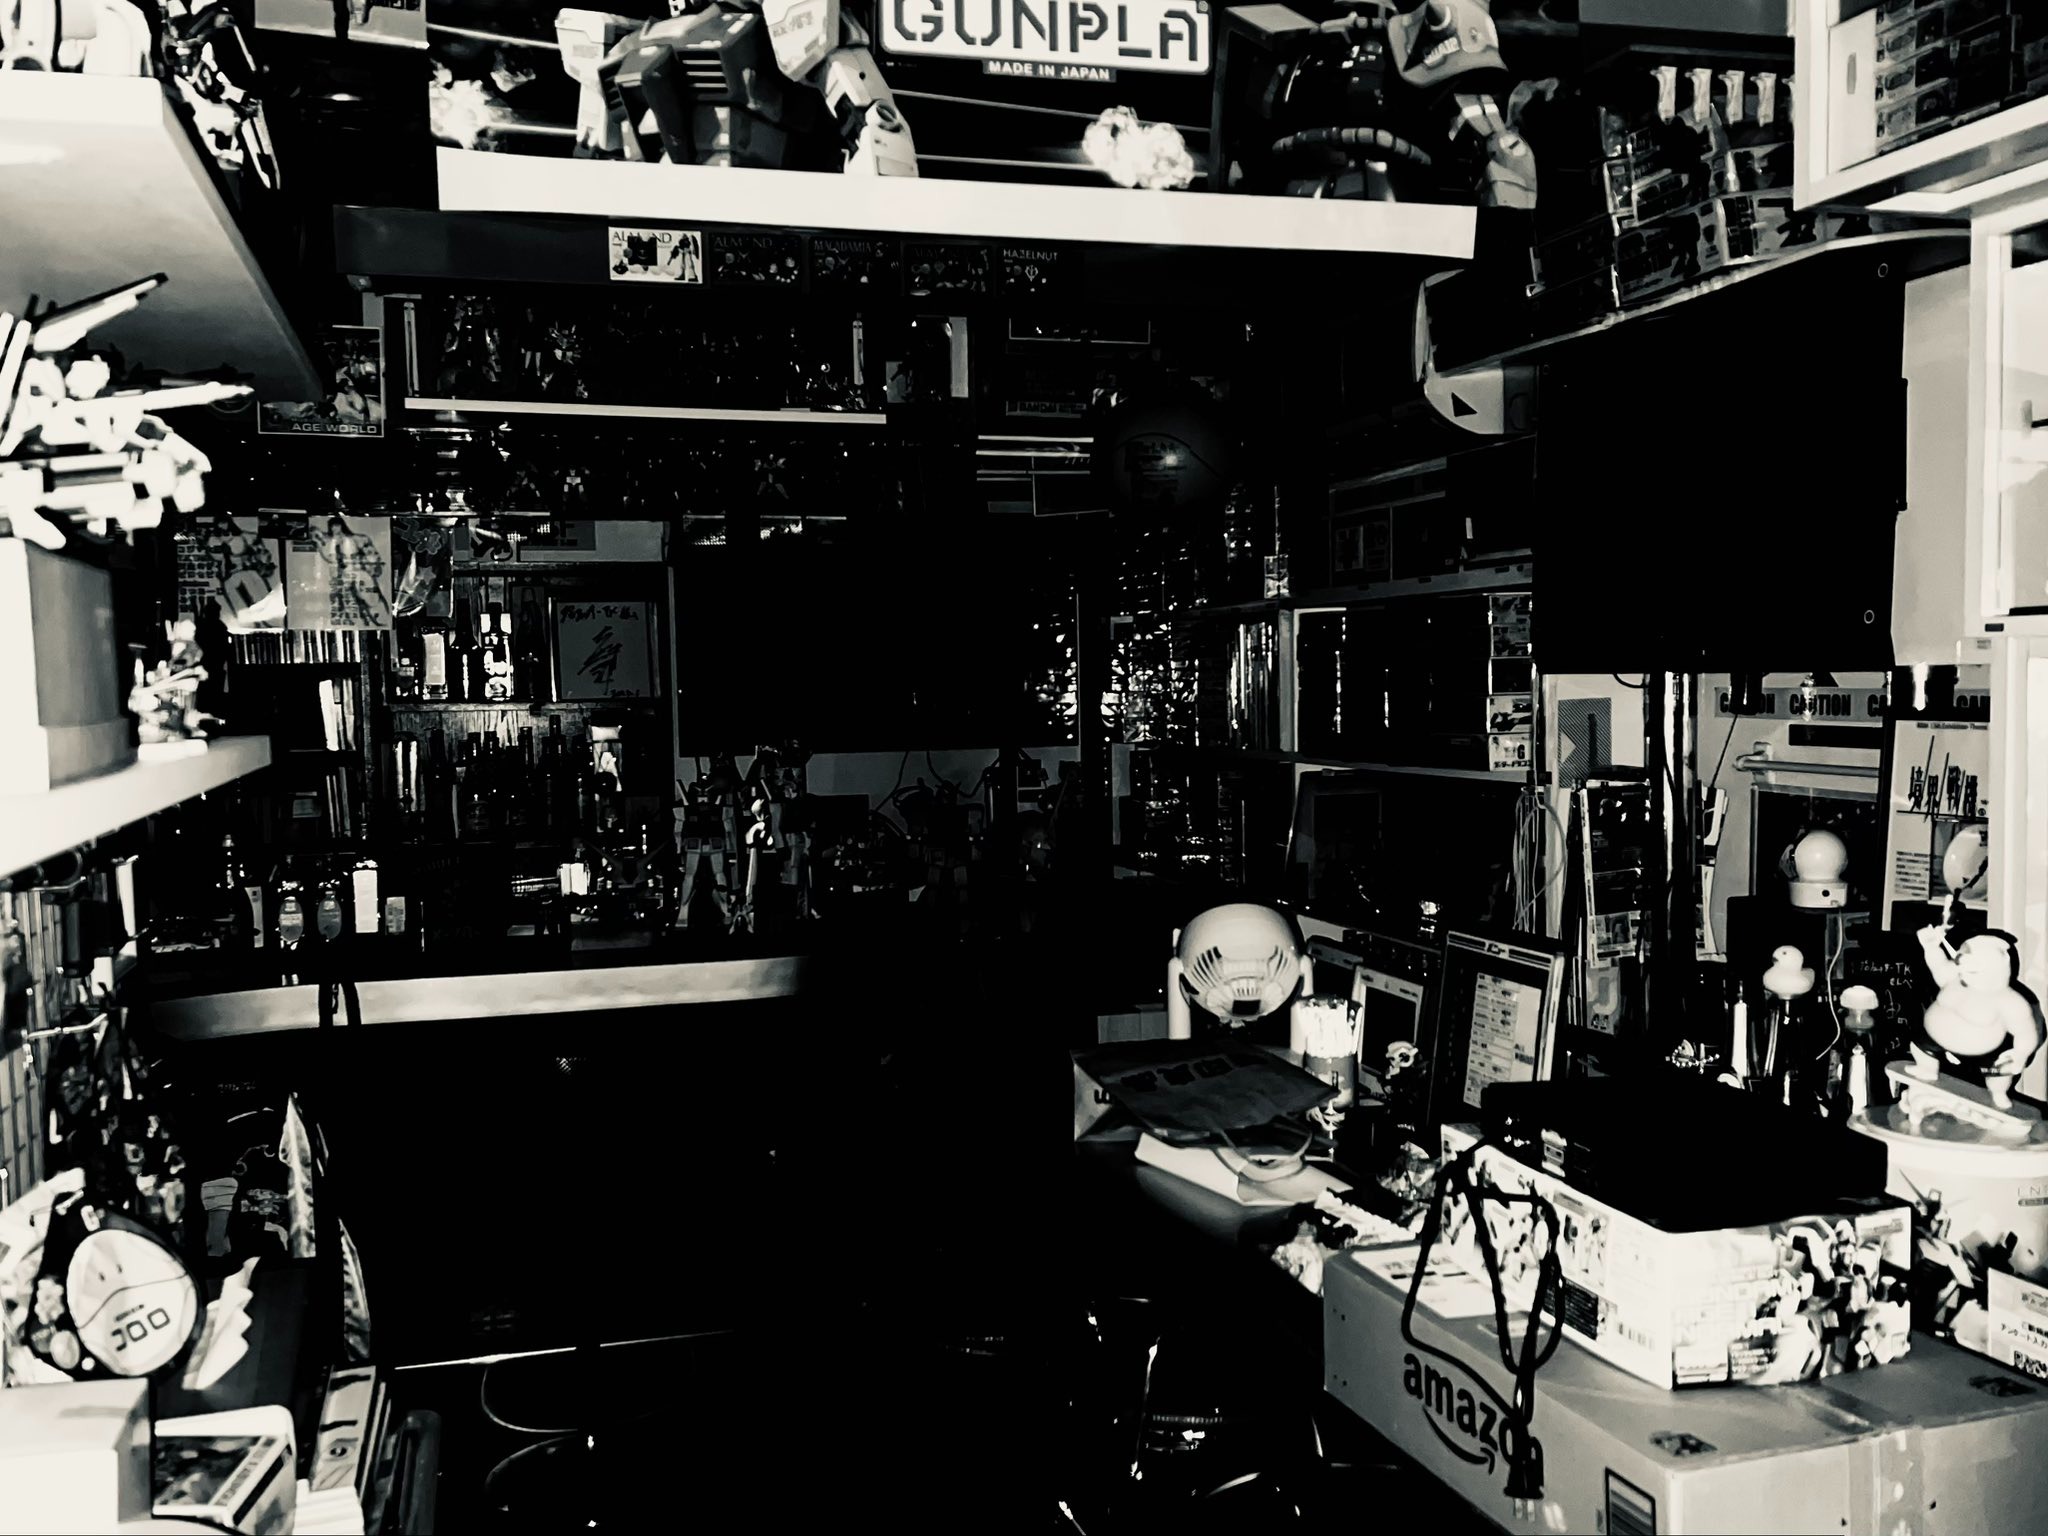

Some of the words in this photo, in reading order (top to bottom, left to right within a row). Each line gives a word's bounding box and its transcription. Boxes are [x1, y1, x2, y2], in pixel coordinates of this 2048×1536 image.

[894, 0, 1198, 62] GUNPLA
[988, 60, 1032, 75] MADE
[1039, 64, 1055, 77] IN
[1061, 66, 1110, 81] JAPAN
[612, 230, 672, 243] ALND
[714, 237, 773, 249] ALMND
[1003, 248, 1058, 262] HAZELNUT
[292, 422, 321, 432] AGE
[326, 423, 378, 434] WORLD
